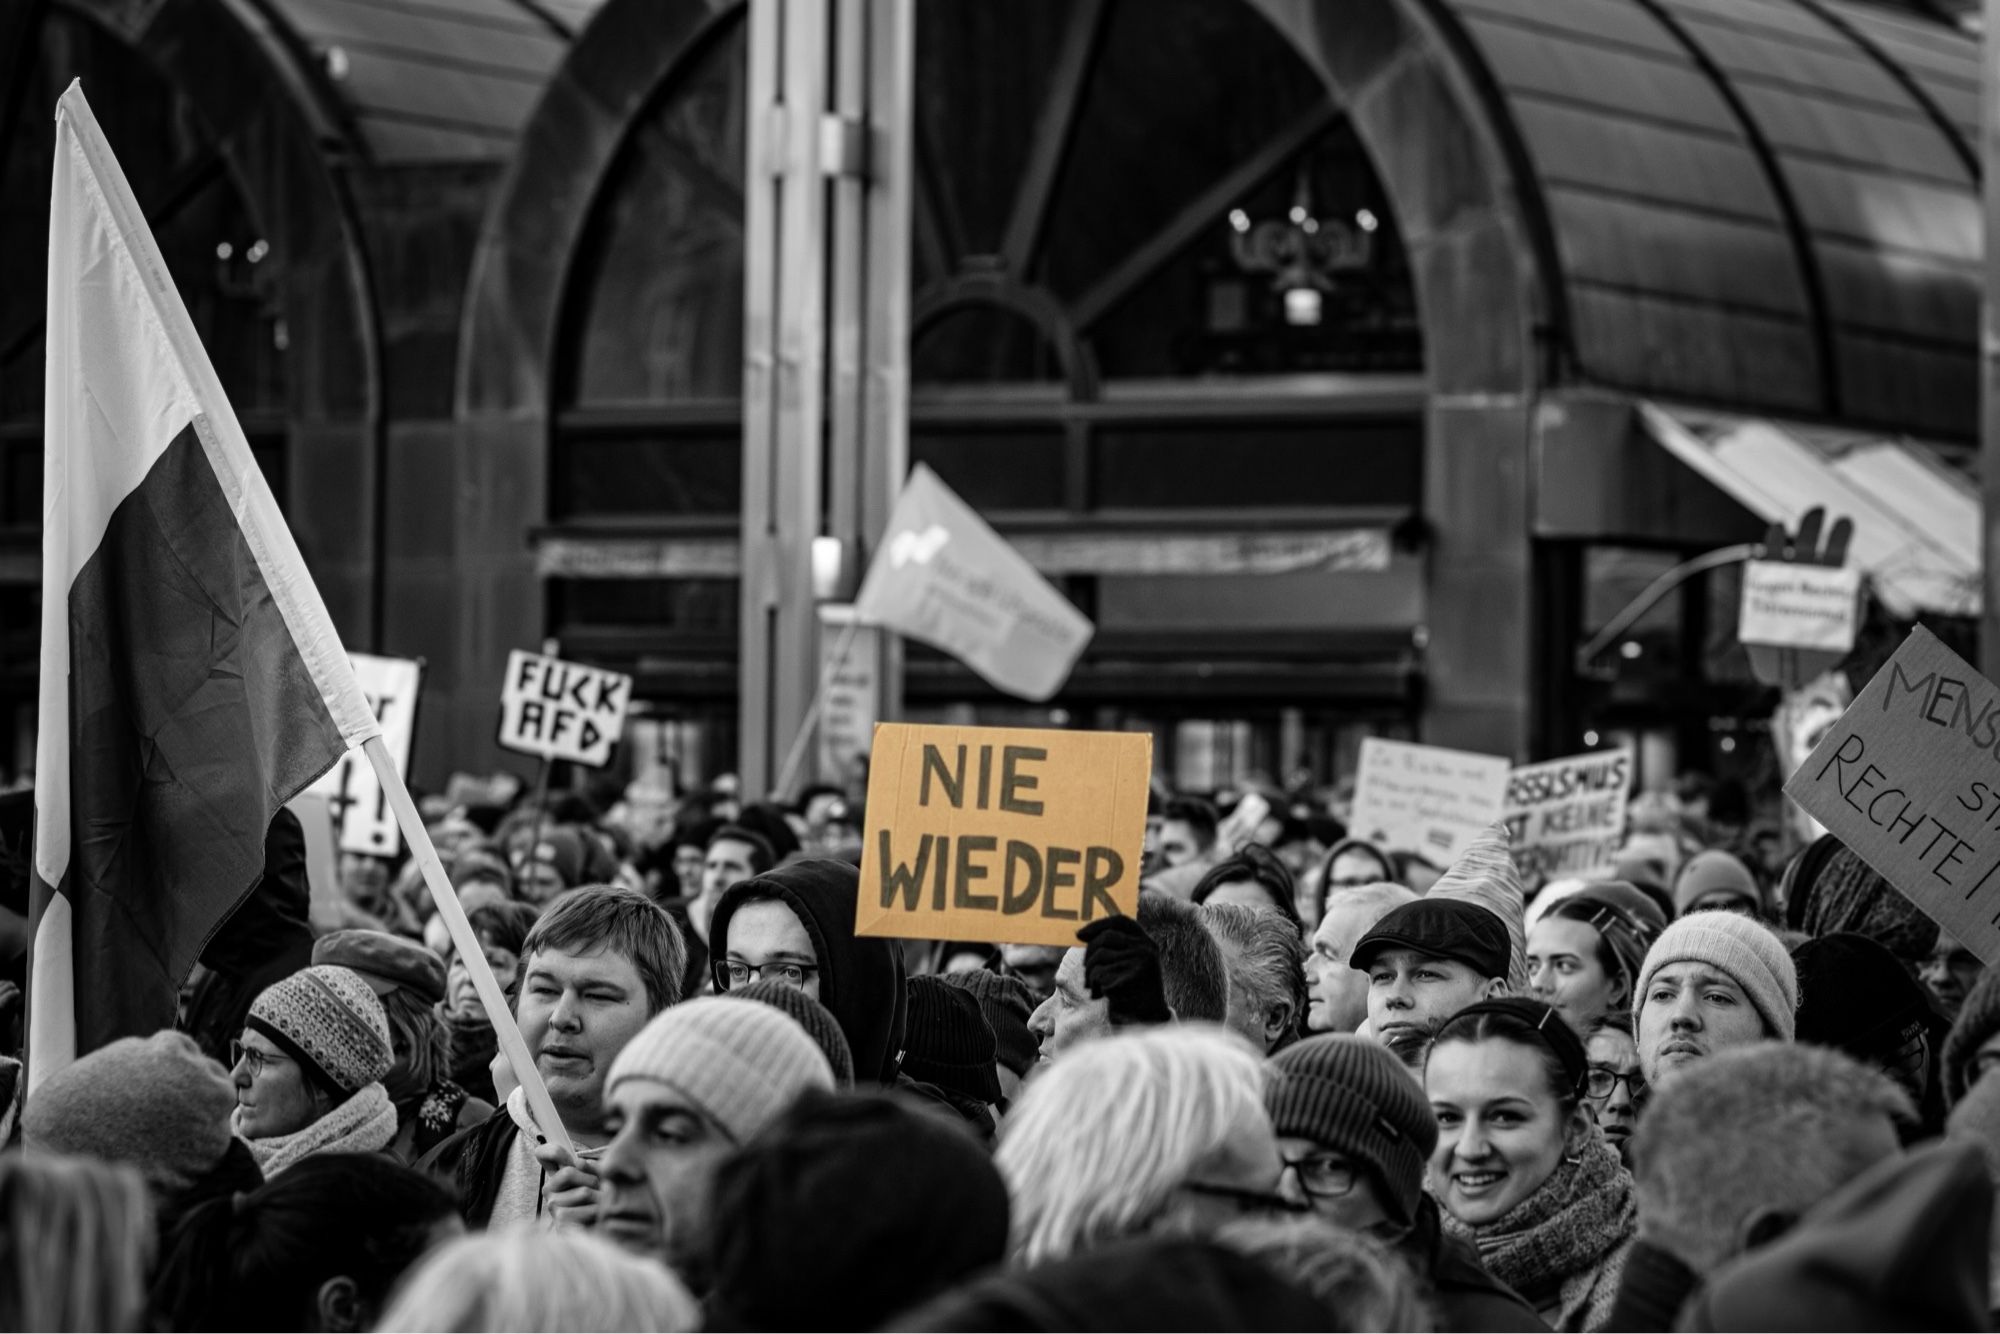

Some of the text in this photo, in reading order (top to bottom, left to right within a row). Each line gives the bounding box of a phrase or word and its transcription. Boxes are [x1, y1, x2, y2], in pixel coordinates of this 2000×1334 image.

[518, 660, 622, 714] FUCK
[518, 701, 601, 750] AFD
[1882, 660, 2000, 763] MENS
[918, 743, 1048, 816] NIE
[1815, 733, 1976, 886] RECHTE
[878, 829, 1125, 922] WIEDER
